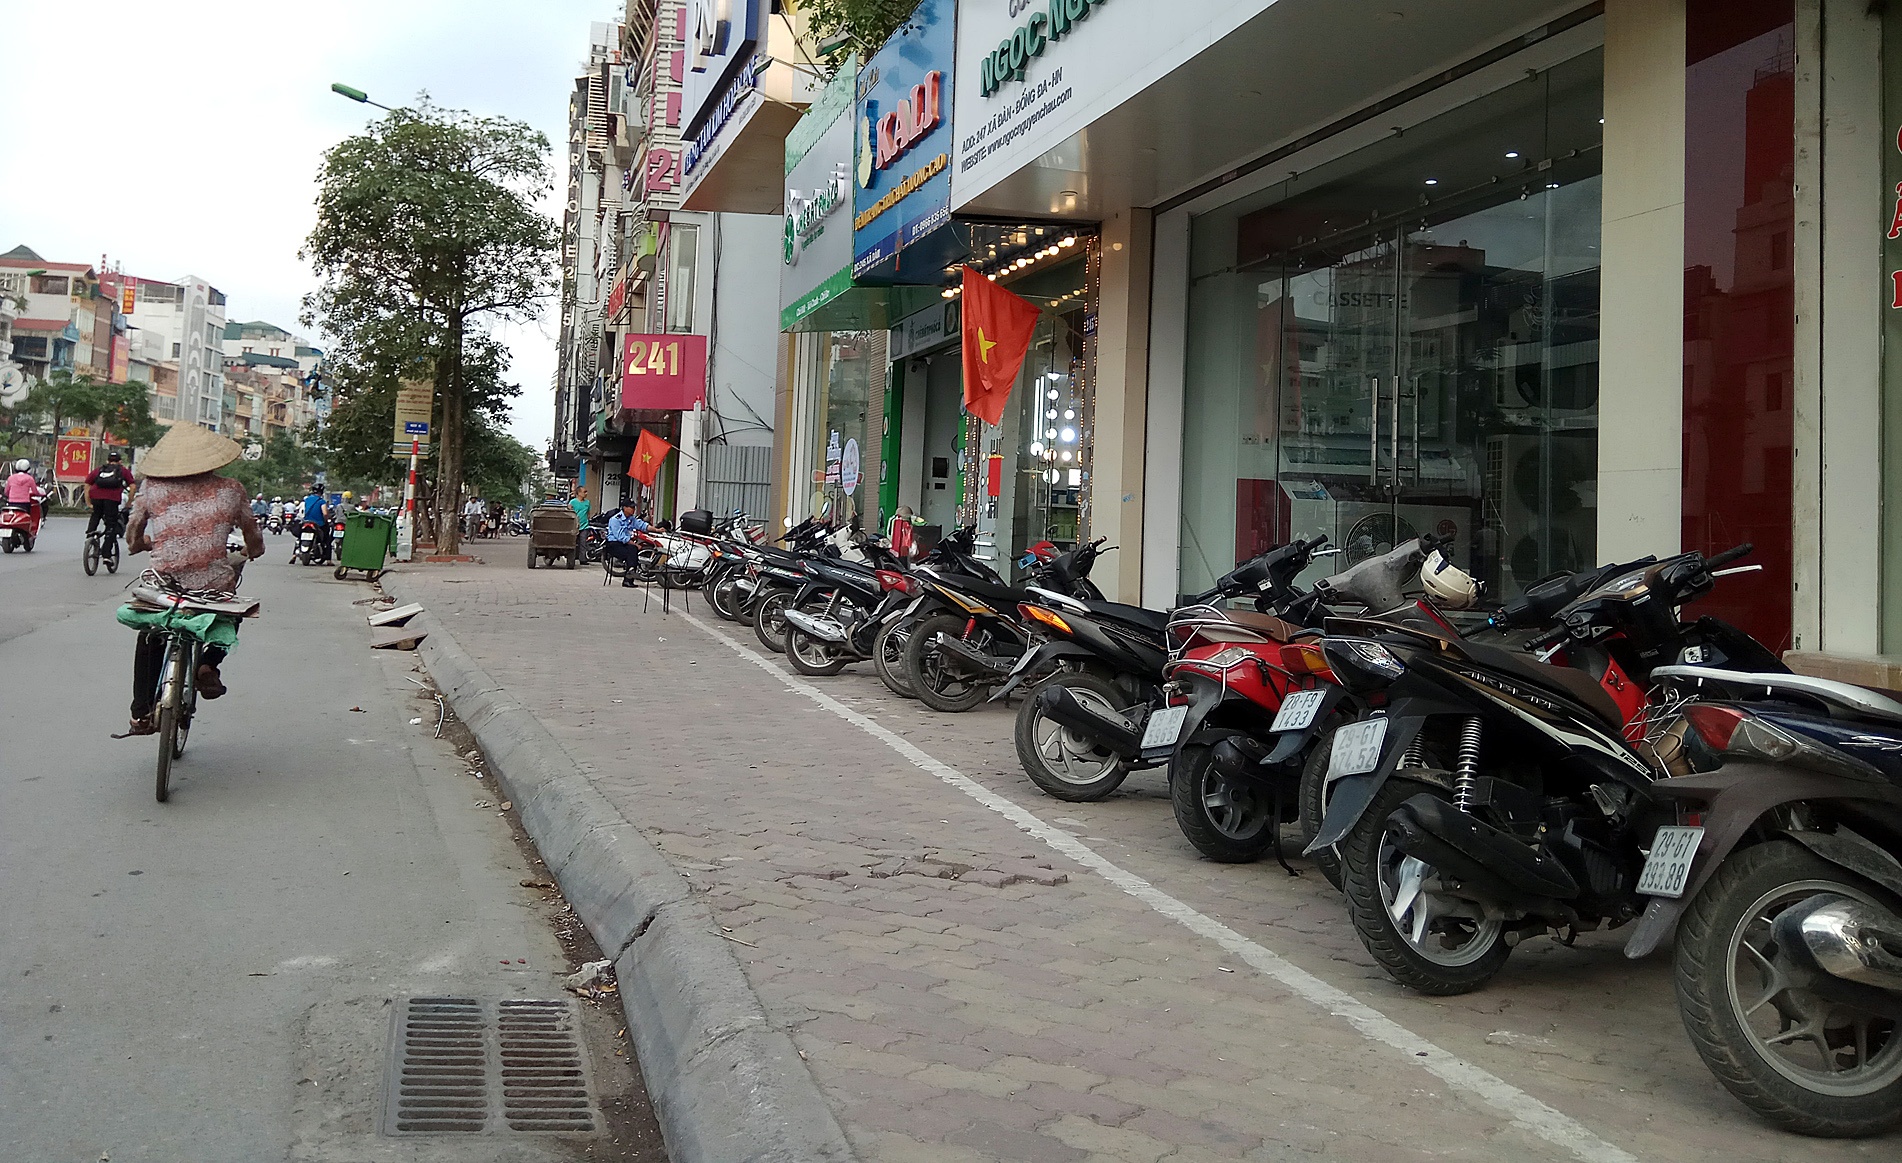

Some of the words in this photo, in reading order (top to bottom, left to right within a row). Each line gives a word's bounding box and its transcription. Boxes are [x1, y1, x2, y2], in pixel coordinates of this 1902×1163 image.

[980, 12, 1046, 97] NGỌC
[876, 70, 940, 171] KALI
[1314, 291, 1408, 309] CASSETTE
[628, 341, 678, 375] 241
[1284, 692, 1318, 711] 28-F9
[1278, 710, 1309, 729] 1433
[1338, 723, 1378, 751] 29-G1
[1654, 831, 1695, 859] 29-G1
